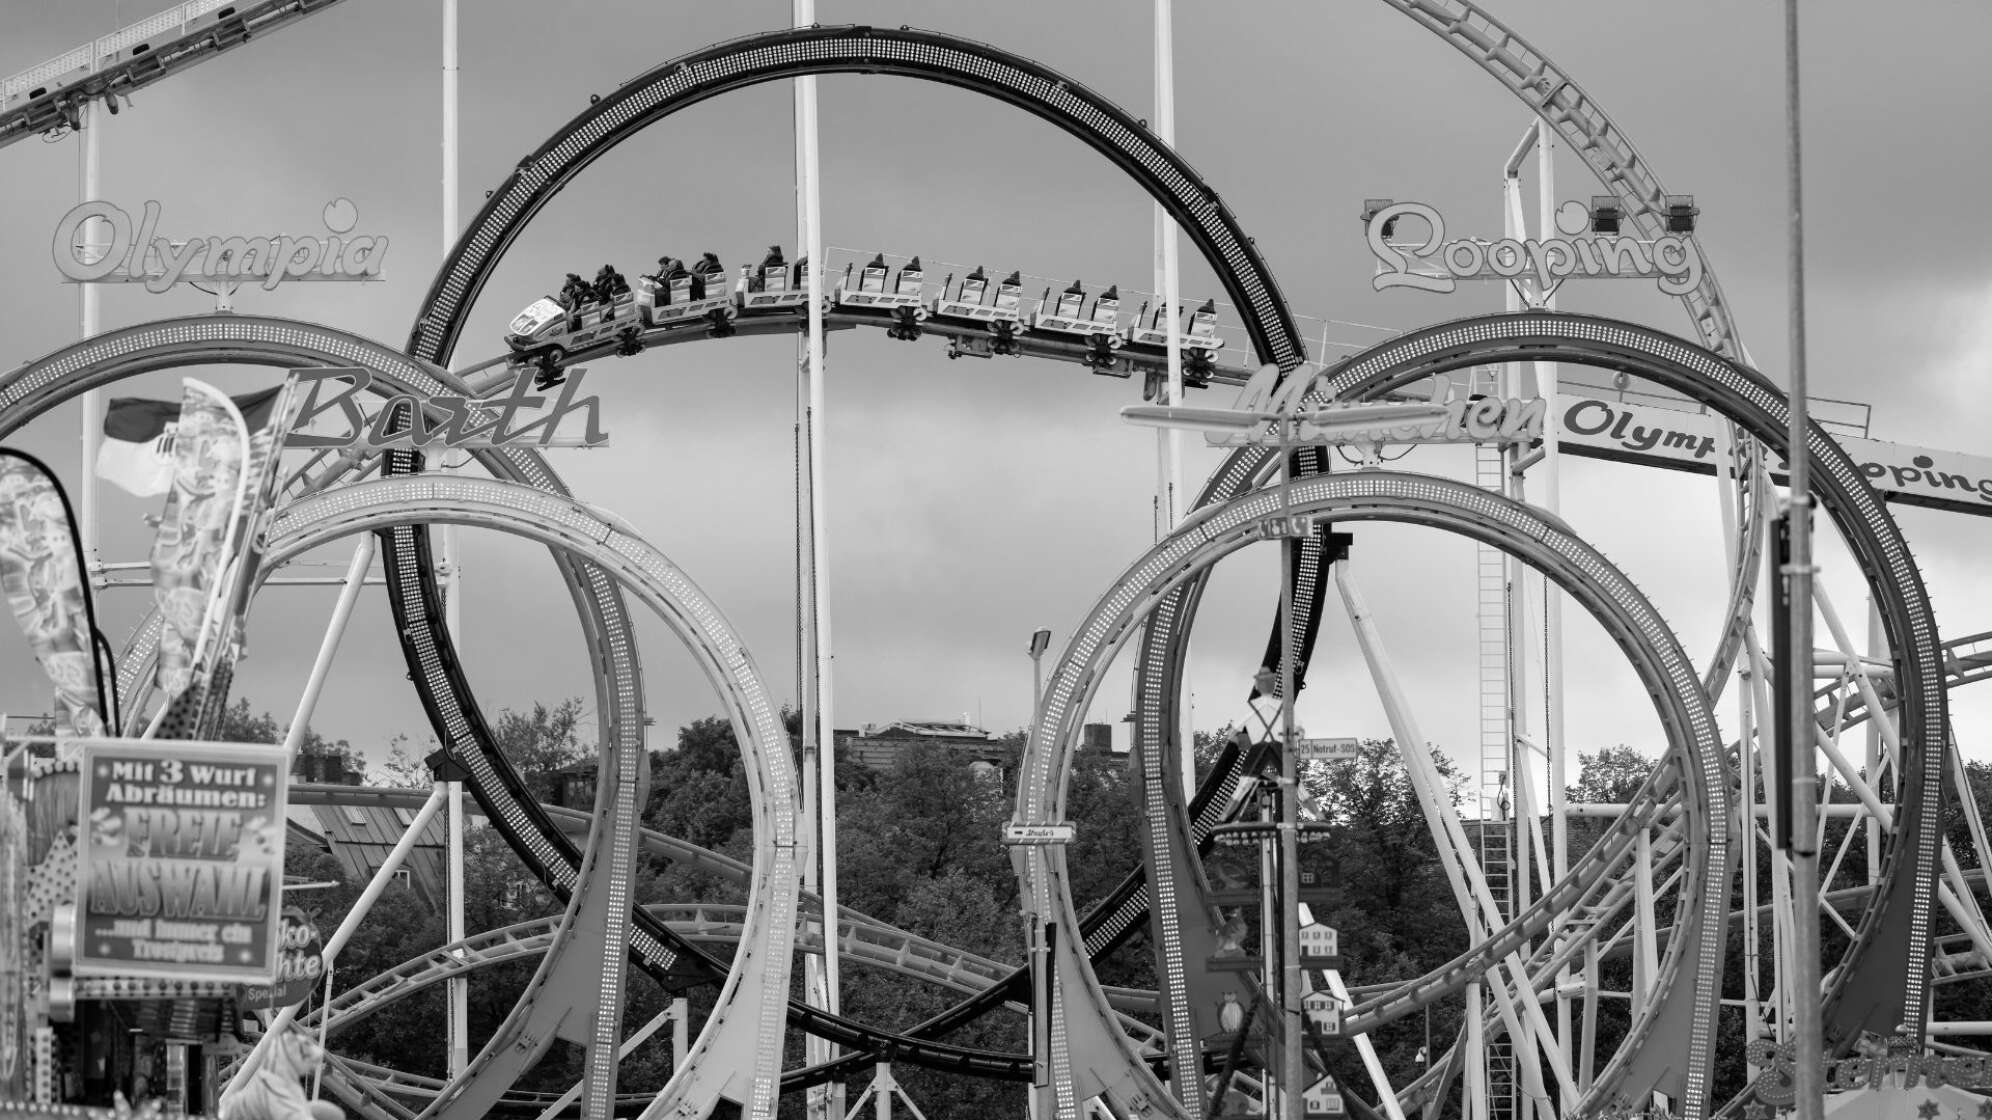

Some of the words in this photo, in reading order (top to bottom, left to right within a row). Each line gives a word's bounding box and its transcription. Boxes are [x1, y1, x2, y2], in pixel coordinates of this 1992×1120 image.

[53, 197, 389, 293] Olympia
[1367, 201, 1703, 296] Looping
[286, 366, 610, 448] Barth
[105, 783, 266, 808] Abräumen:
[112, 760, 154, 781] Mit
[159, 758, 184, 784] 3
[123, 806, 242, 859] FREIE
[88, 860, 269, 920] AUSWAHL
